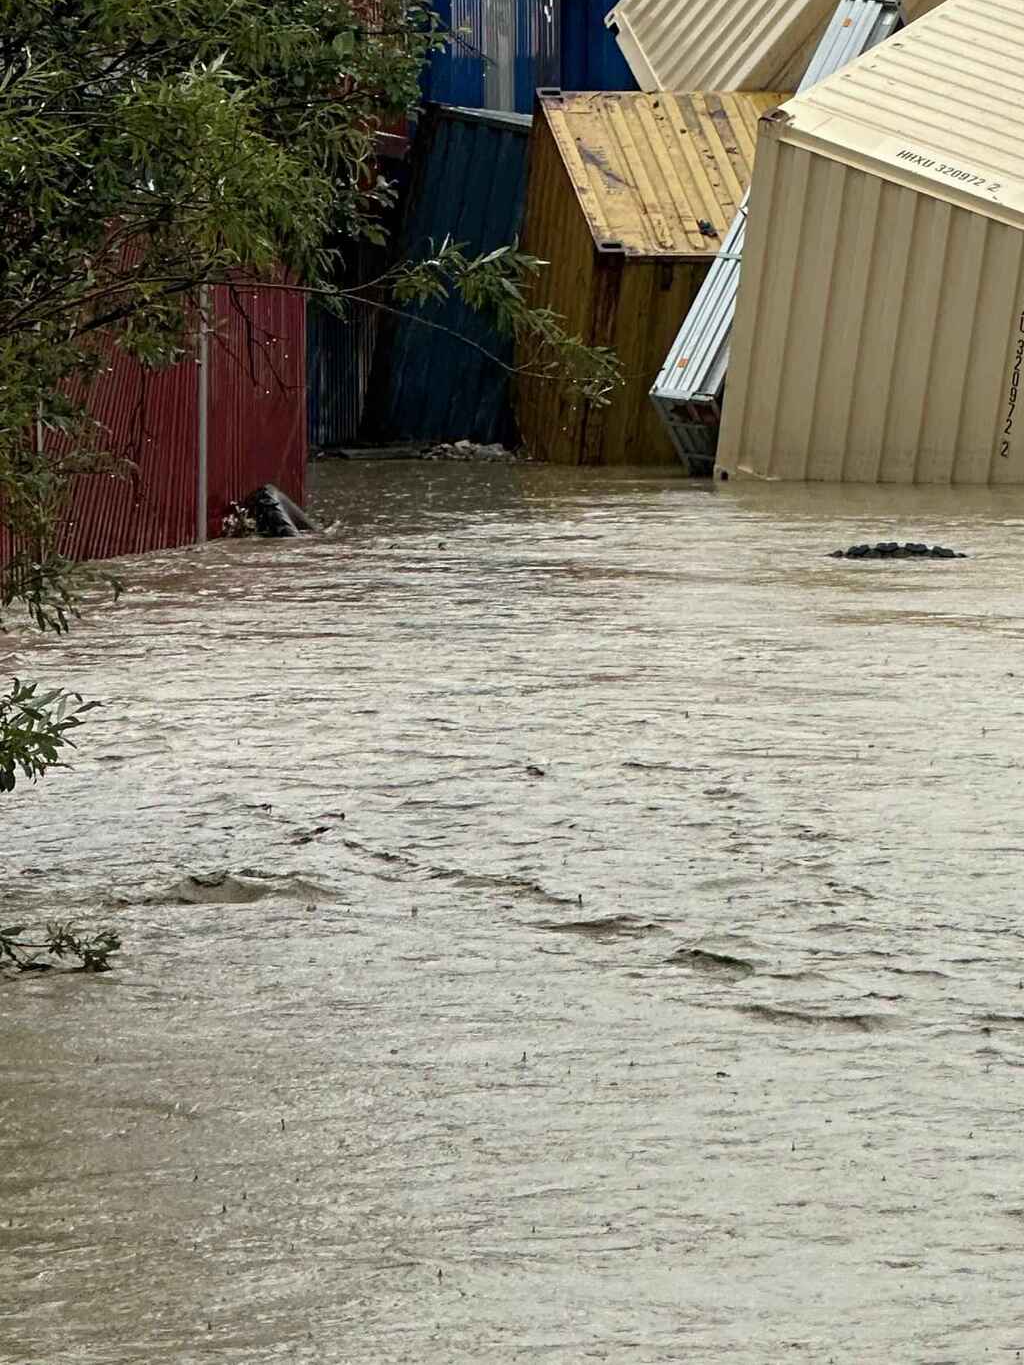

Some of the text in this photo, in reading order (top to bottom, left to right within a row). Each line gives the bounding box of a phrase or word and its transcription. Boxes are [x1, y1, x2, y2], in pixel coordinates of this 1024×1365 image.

[896, 149, 1001, 193] HHXU 320972 2
[1000, 440, 1010, 458] 2
